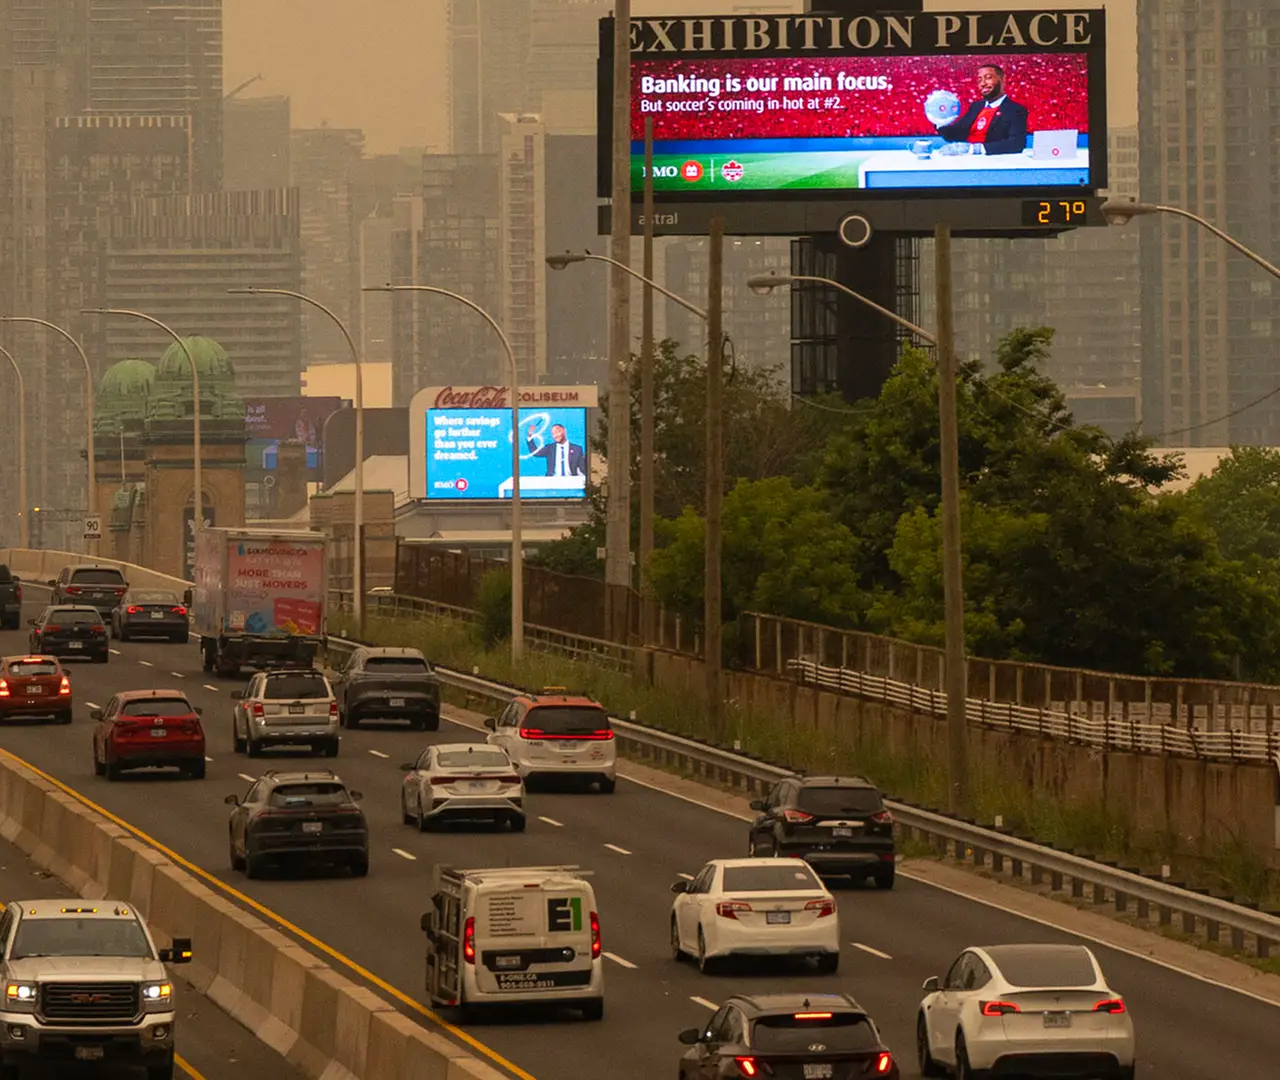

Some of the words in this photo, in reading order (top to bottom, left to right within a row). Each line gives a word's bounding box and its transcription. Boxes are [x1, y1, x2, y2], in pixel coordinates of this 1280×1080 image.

[933, 13, 1092, 47] PLACE
[641, 74, 720, 96] Banking
[725, 73, 741, 92] is
[746, 76, 778, 92] our
[783, 73, 833, 91] main
[837, 71, 893, 91] focus.
[641, 99, 662, 112] But
[666, 96, 715, 112] soccer's
[718, 97, 764, 113] coming
[767, 96, 780, 110] in
[782, 96, 804, 110] hot
[807, 97, 820, 110] at
[824, 96, 845, 110] #2.
[638, 212, 678, 225] atral
[435, 386, 509, 409] Coca-Cola
[434, 416, 464, 425] Where
[466, 416, 500, 428] savings
[434, 428, 447, 438] go
[448, 428, 481, 437] further
[434, 440, 456, 449] than
[457, 441, 475, 451] you
[476, 440, 498, 449] ever
[434, 450, 479, 460] dreamed.
[87, 521, 98, 531] 90
[238, 569, 270, 578] MORE
[271, 569, 302, 579] THAN
[234, 579, 260, 588] JUST
[262, 580, 308, 590] MOVERS
